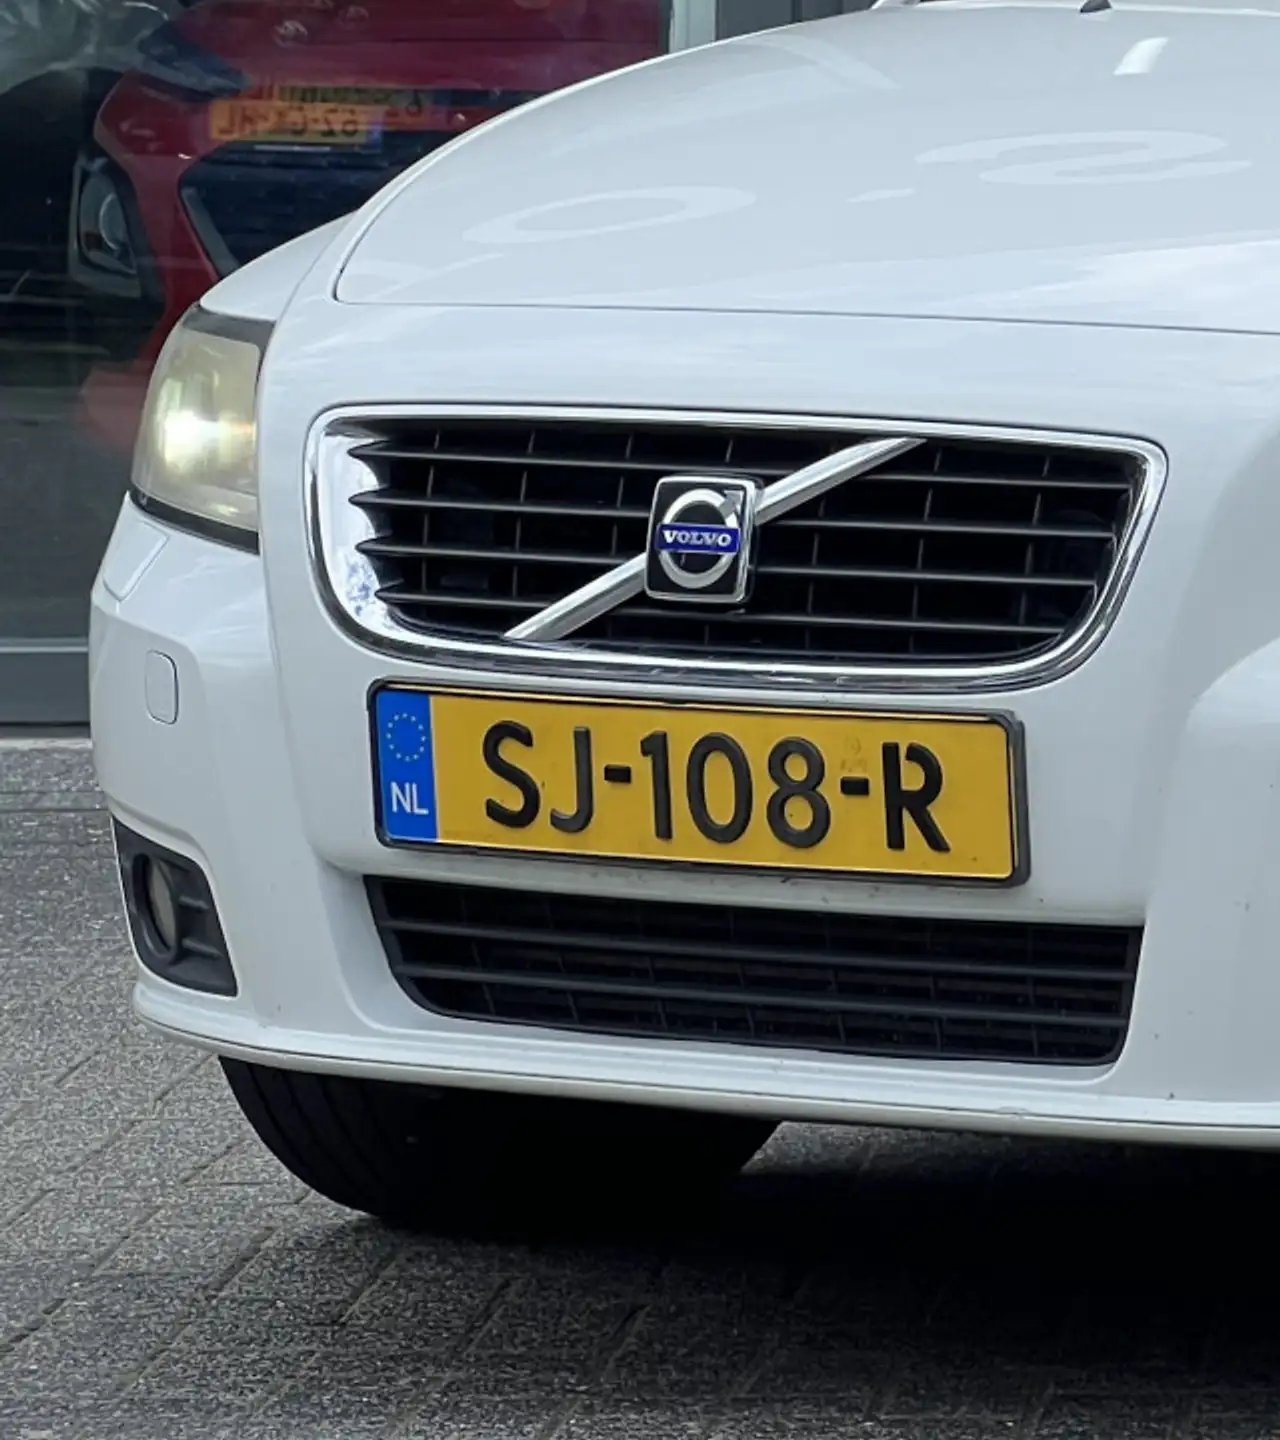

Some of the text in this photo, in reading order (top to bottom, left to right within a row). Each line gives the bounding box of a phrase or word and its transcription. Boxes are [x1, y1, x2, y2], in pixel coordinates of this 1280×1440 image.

[662, 529, 732, 548] VOLVO
[390, 781, 429, 816] NL
[482, 718, 951, 853] SJ-108-R
